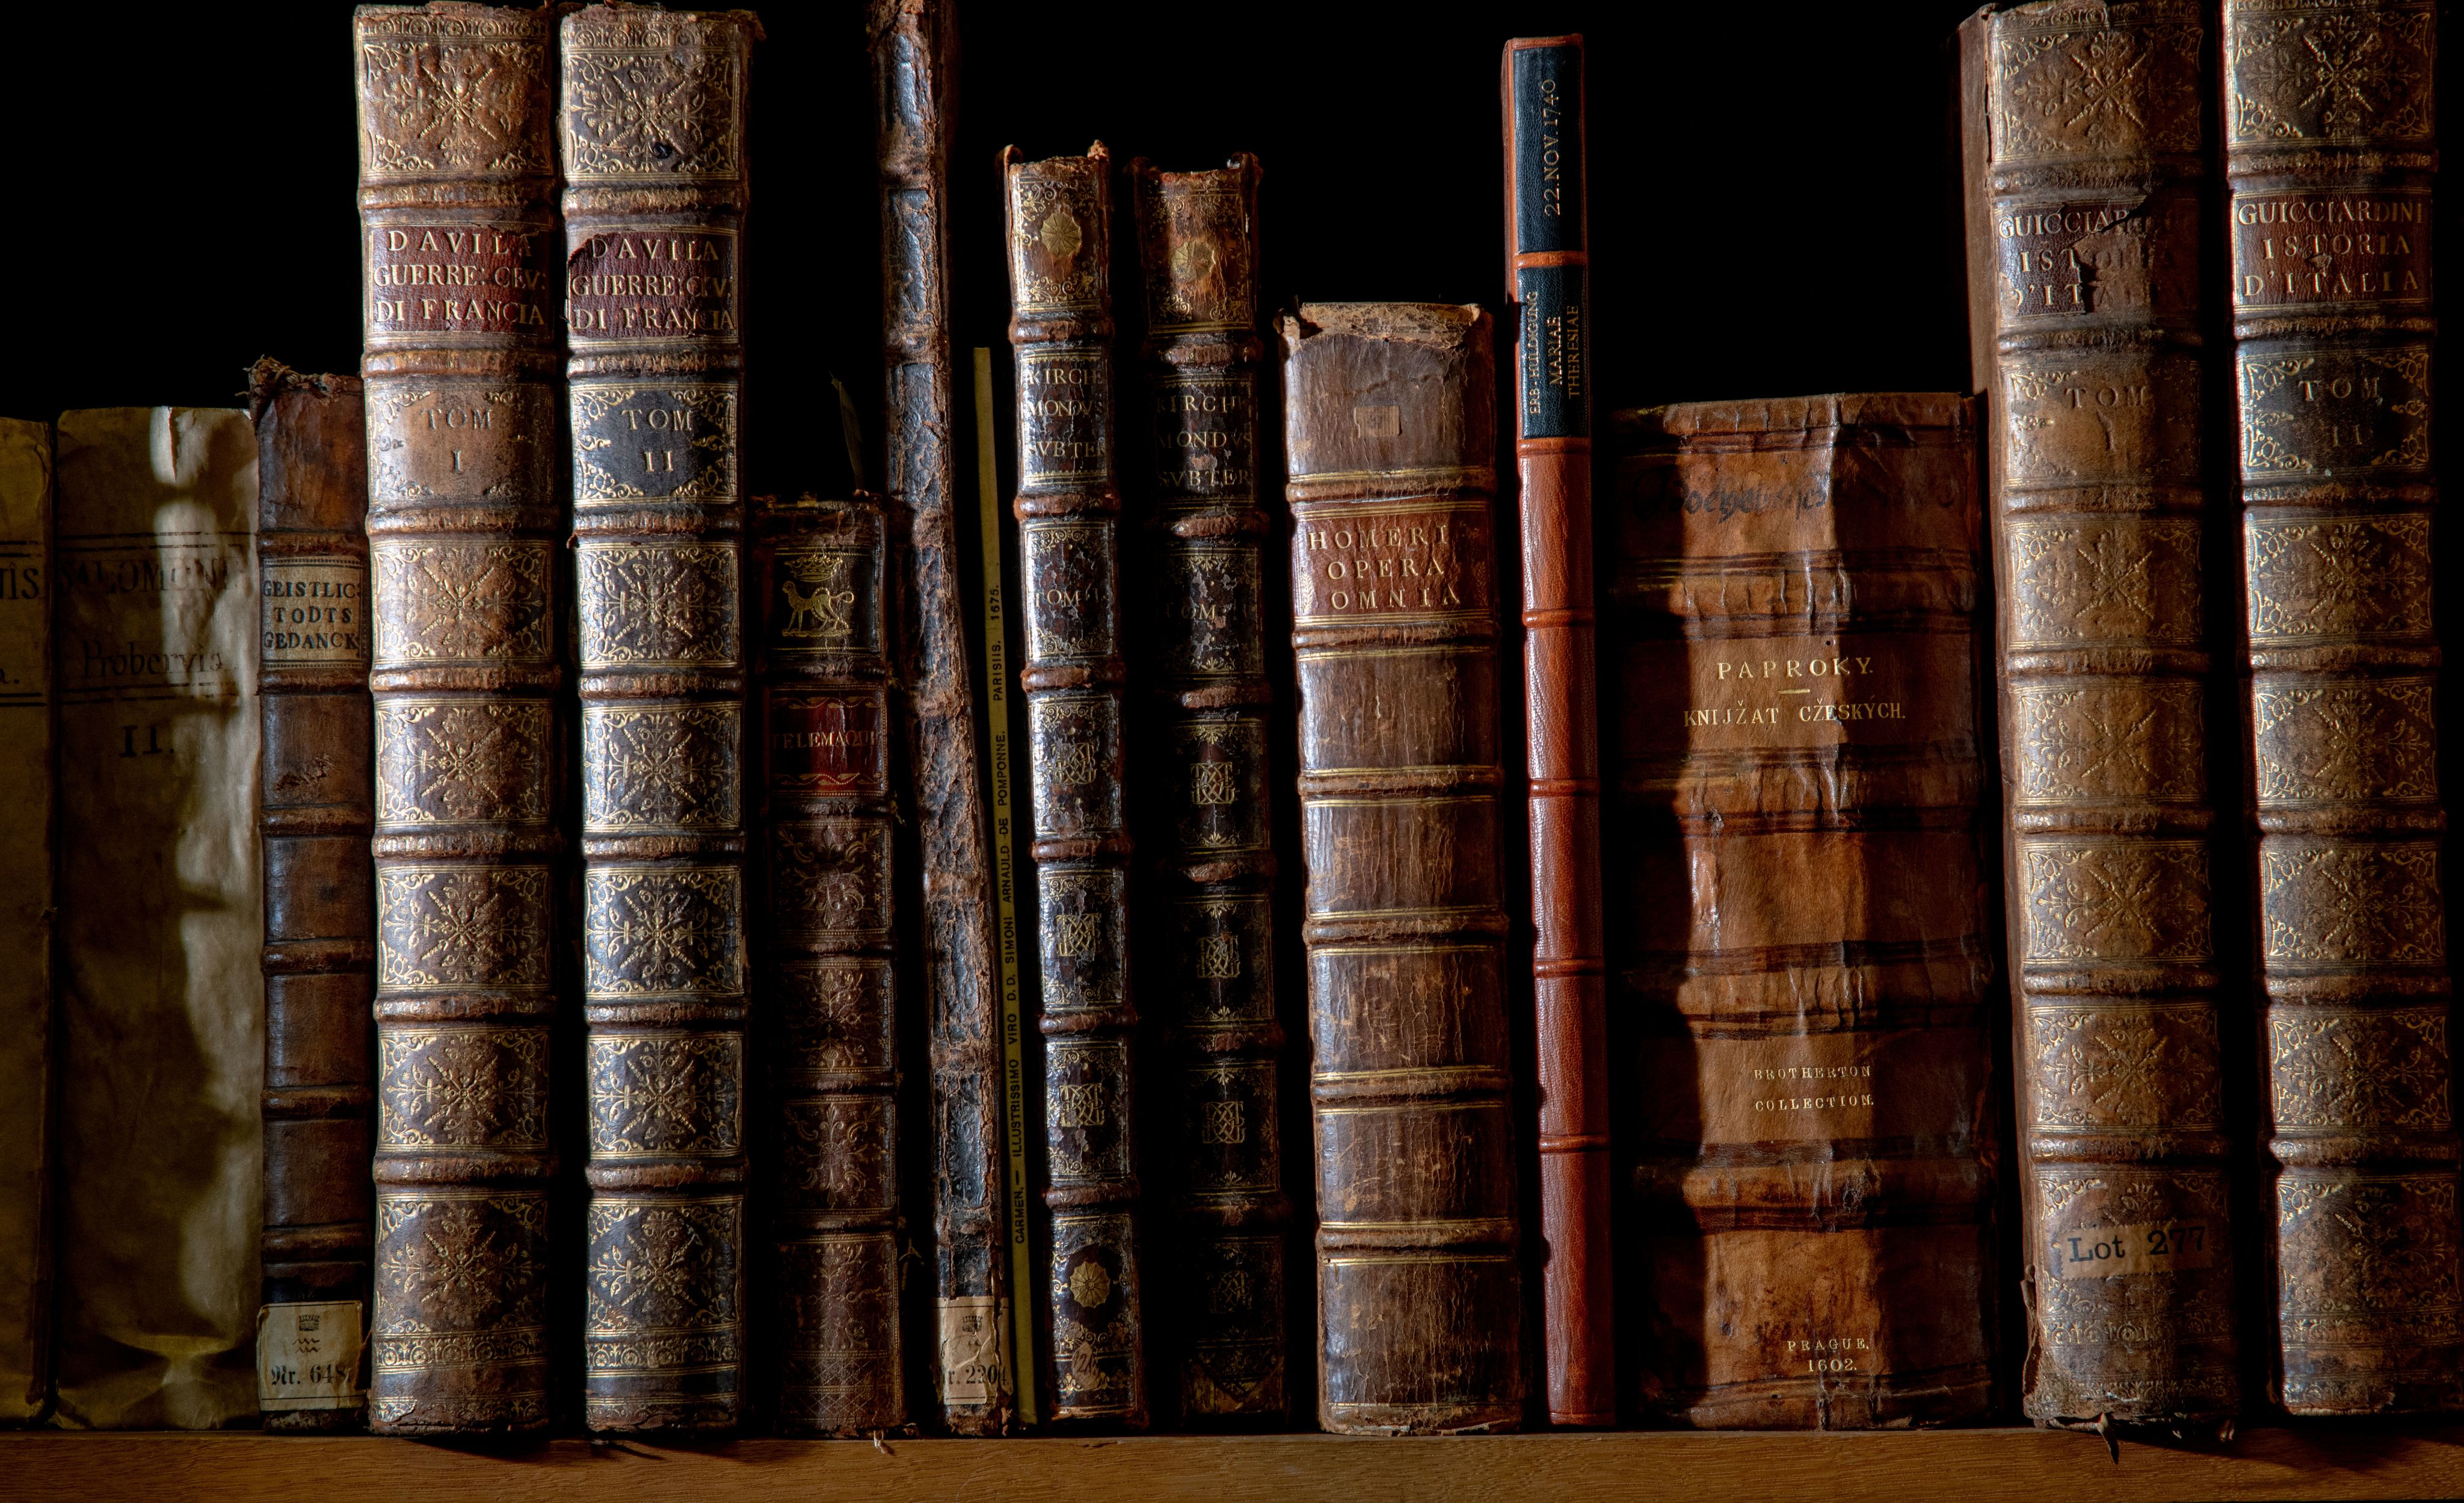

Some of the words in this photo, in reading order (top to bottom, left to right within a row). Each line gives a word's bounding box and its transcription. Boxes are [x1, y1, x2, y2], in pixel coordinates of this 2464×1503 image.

[2238, 200, 2424, 226] GUICCIARDINI
[387, 230, 534, 257] DAVILA
[591, 238, 719, 260] DAVILA
[2261, 233, 2411, 259] ISTORIA
[2244, 270, 2419, 297] D'ITALIA
[376, 300, 405, 323] DI
[421, 298, 545, 326] FRANCIA
[573, 309, 606, 330] DI
[623, 307, 736, 330] FRANCIA
[1546, 316, 1563, 386] MARIAE
[1566, 304, 1580, 400] THERESIAE
[2064, 384, 2146, 409] TOM
[2297, 377, 2380, 402] TOM
[420, 407, 492, 430] TOM
[621, 407, 696, 431] TOM
[452, 449, 463, 473] I
[644, 450, 674, 473] II
[1308, 525, 1447, 551] HOMERI
[1327, 557, 1445, 580] OPERA
[1330, 584, 1461, 610] OMNIA
[273, 605, 352, 624] TODTS
[991, 640, 1003, 701] PARISIIS.
[1717, 656, 1874, 680] PAPROKY.
[995, 730, 1008, 806] POMPONNE.
[998, 818, 1009, 835] DE
[1000, 845, 1012, 903] ARNAULD
[1002, 916, 1015, 964] SIMONI
[1006, 1013, 1018, 1045] VIRO
[1753, 1065, 1871, 1080] BROTHERTON
[1008, 1059, 1022, 1157] ILLUSTRISSIMO
[1755, 1093, 1874, 1112] COLLECTION.
[1013, 1187, 1025, 1245] CARMEN.
[2067, 1235, 2125, 1262] Lot
[2148, 1225, 2205, 1255] 277
[1787, 1338, 1870, 1352] PRAGUE.
[271, 1365, 301, 1386] Nr.
[1807, 1357, 1858, 1372] 1602.
